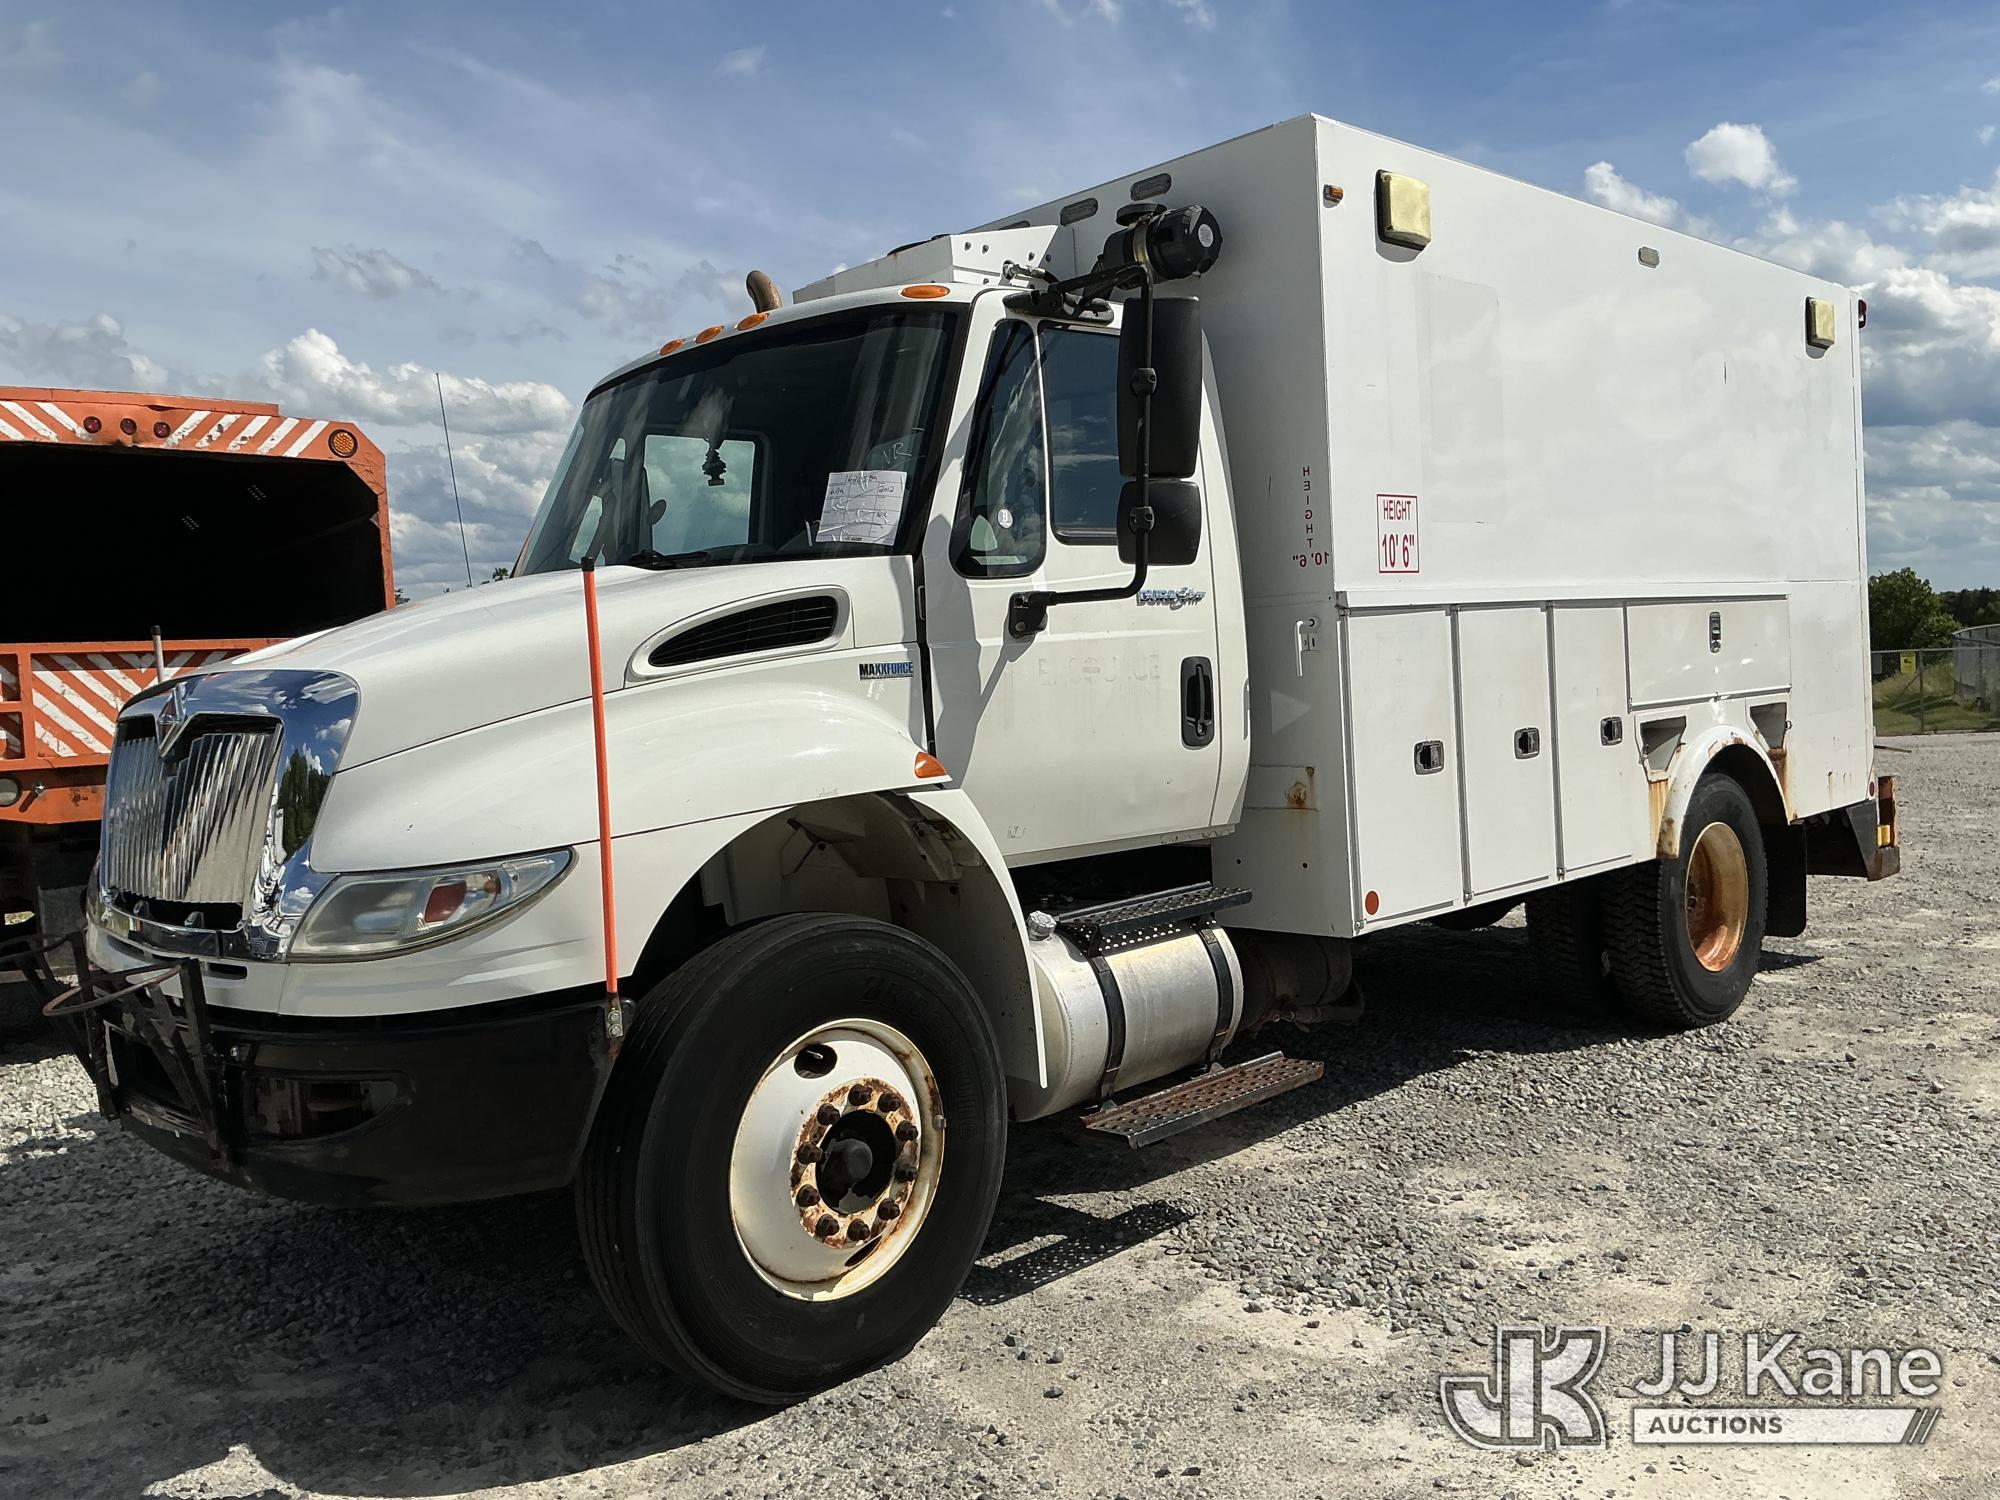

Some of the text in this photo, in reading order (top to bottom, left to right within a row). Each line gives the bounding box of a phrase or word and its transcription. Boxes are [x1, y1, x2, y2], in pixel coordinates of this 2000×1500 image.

[1382, 500, 1412, 520] HEIGHT
[1381, 534, 1415, 568] 10' 6"
[859, 661, 914, 676] MAXXFORCE
